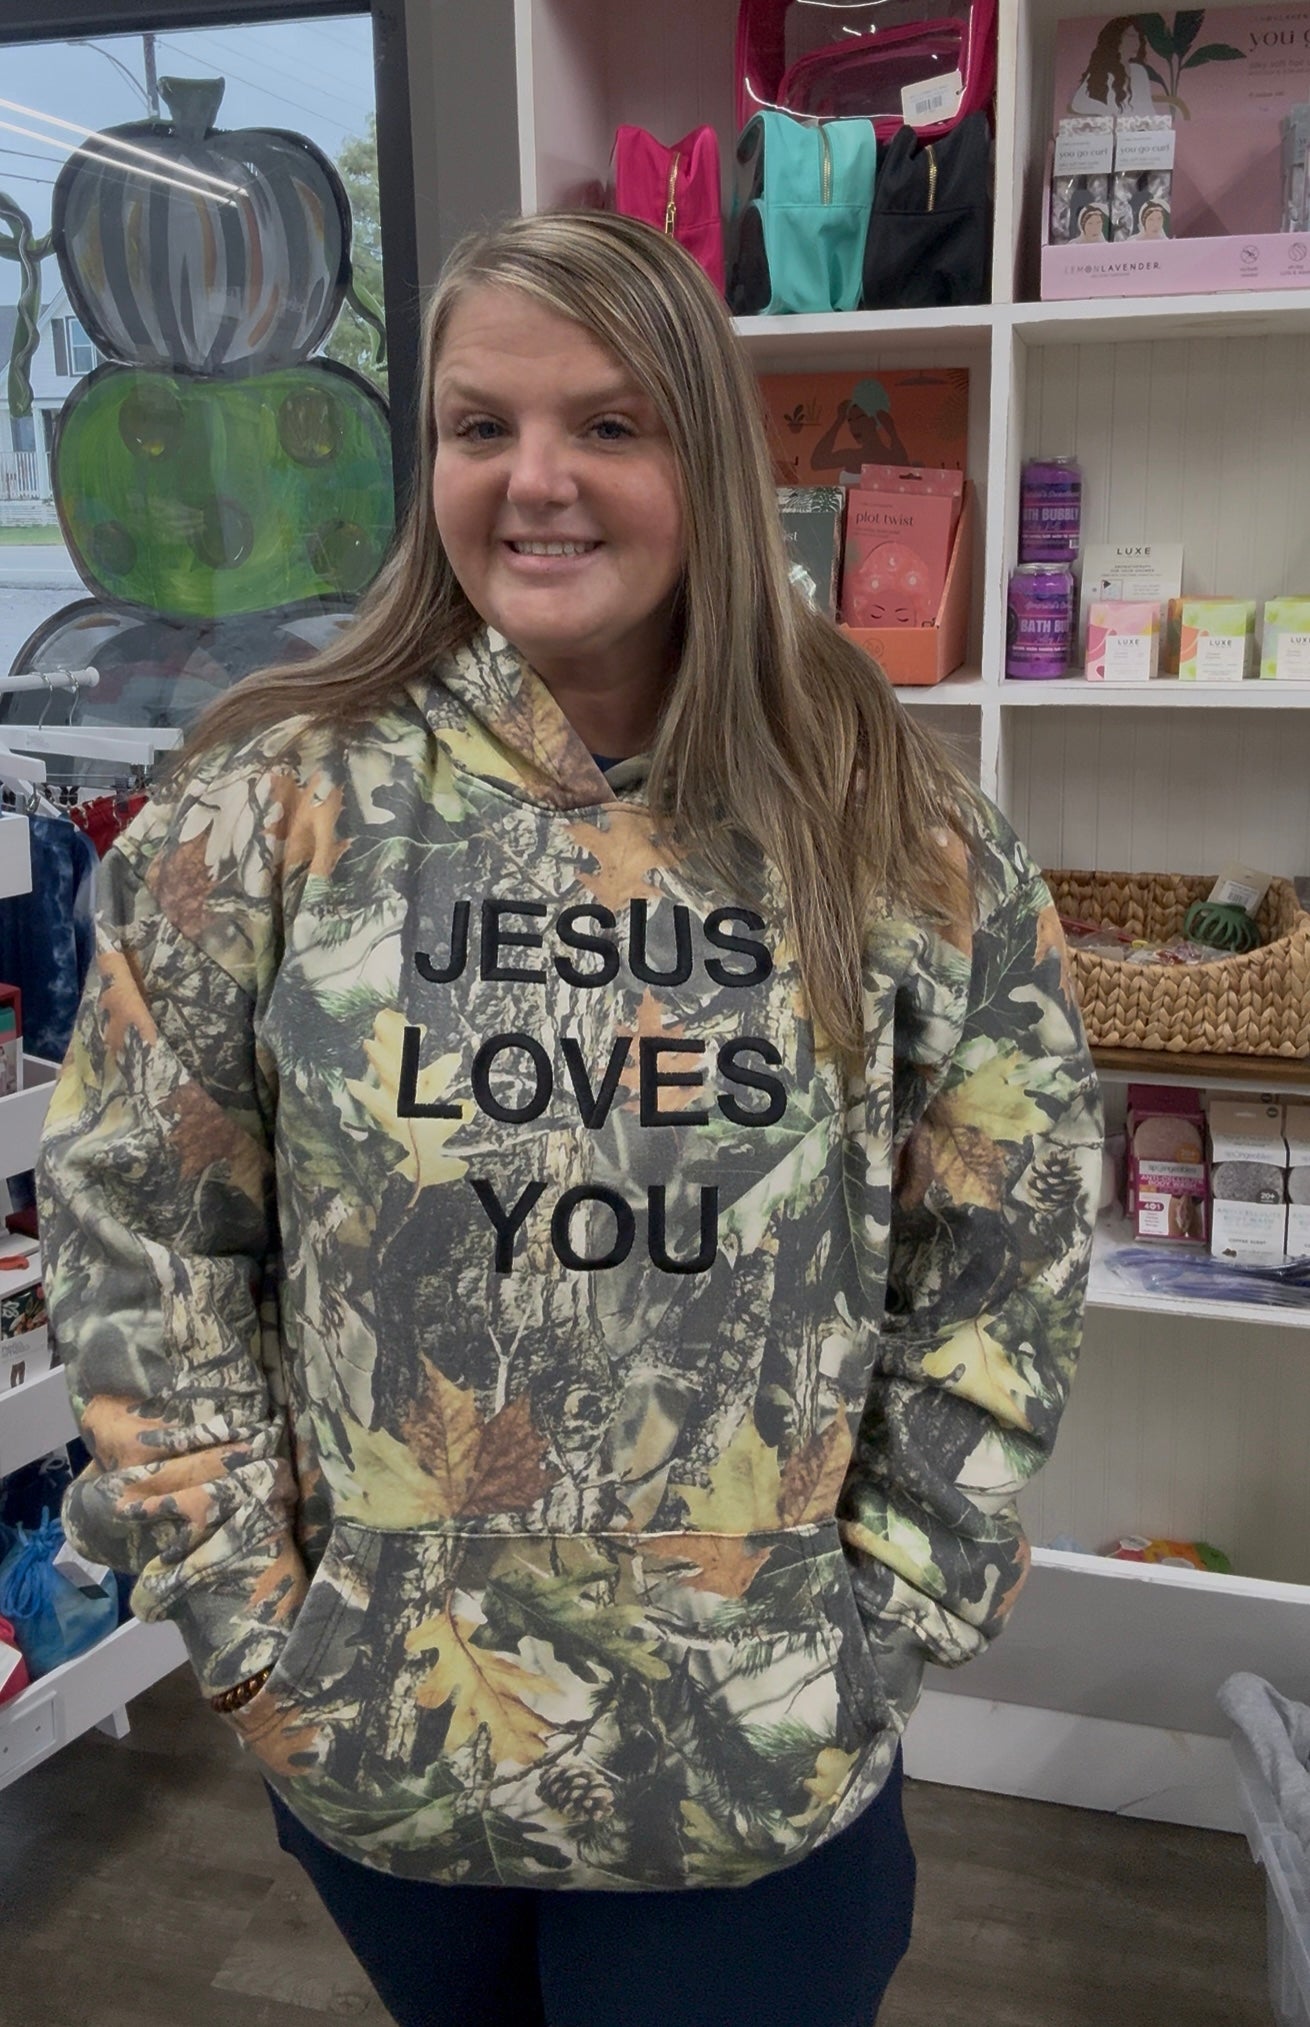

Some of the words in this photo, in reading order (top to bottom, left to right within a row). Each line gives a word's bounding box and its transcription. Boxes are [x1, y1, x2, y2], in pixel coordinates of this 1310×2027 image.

[1249, 30, 1295, 53] you
[856, 512, 879, 525] plot
[883, 514, 913, 528] twist
[1116, 546, 1152, 556] LUXE
[1020, 619, 1051, 633] BATH
[1209, 639, 1232, 647] LUXE
[1290, 636, 1310, 644] LUX
[415, 898, 773, 989] JESUS
[397, 1026, 788, 1130] LOVES
[1260, 1192, 1275, 1200] 20+
[470, 1179, 719, 1275] YOU
